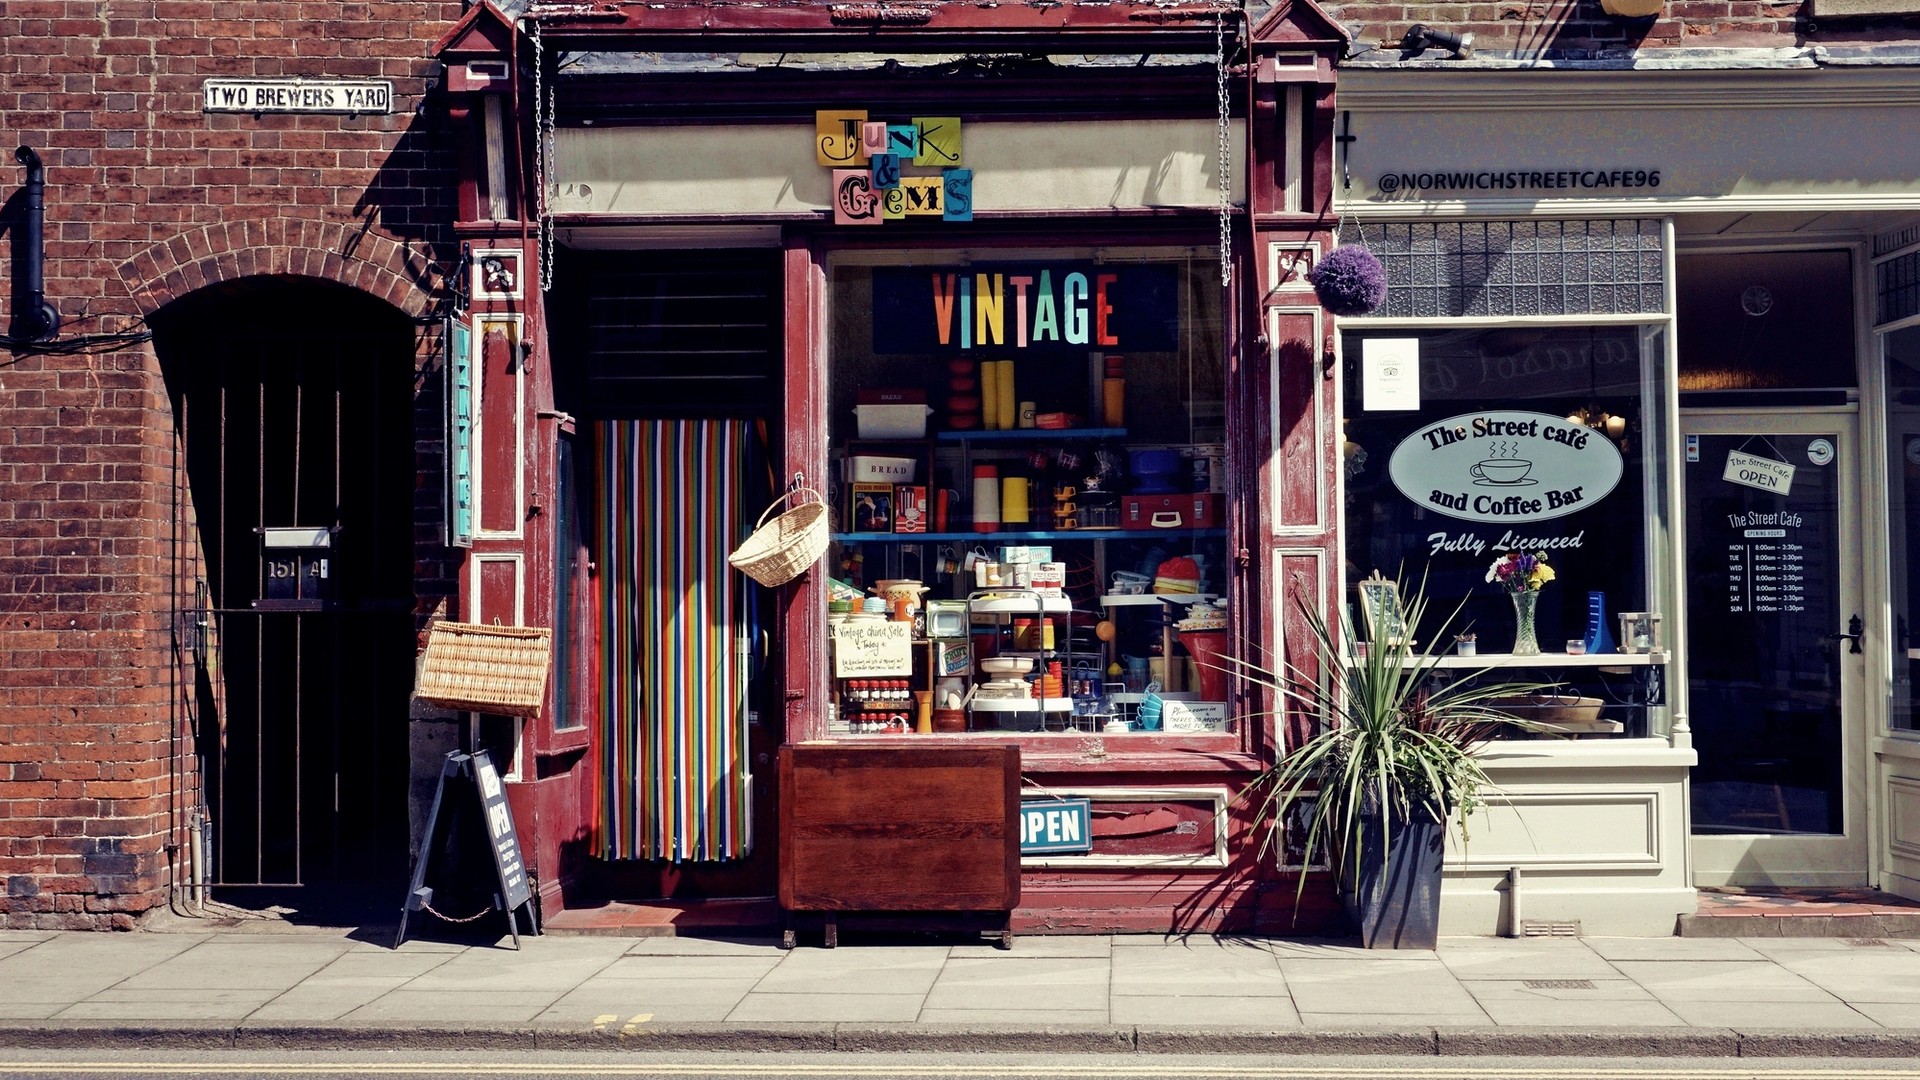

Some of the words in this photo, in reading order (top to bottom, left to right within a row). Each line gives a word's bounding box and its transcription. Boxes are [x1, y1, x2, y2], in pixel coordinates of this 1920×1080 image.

[210, 87, 248, 105] TWO
[256, 88, 334, 107] BREWERS
[345, 88, 386, 107] YARD
[876, 154, 898, 186] &
[1378, 169, 1661, 194] @NORWICHSTREETCAFE96
[932, 269, 1118, 349] VINTAGE
[1422, 425, 1467, 450] The
[1472, 417, 1538, 438] Street
[1543, 424, 1589, 450] café
[871, 465, 907, 475] BREAD
[1731, 458, 1746, 466] The
[1748, 458, 1772, 470] Street
[1773, 465, 1790, 480] Cafe
[1739, 469, 1778, 488] OPEN
[1429, 489, 1469, 511] and
[1473, 495, 1542, 515] Coffee
[1544, 486, 1584, 510] Bar
[1727, 514, 1747, 528] The
[1748, 511, 1778, 525] Street
[1780, 511, 1802, 528] Cafe
[1427, 531, 1486, 556] Fully
[1491, 530, 1584, 551] Licenced
[1782, 544, 1803, 552] 3:30pm
[269, 561, 296, 578] 151
[310, 561, 320, 577] A
[1782, 564, 1804, 572] 3:30pm
[839, 627, 864, 646] Vintage
[867, 626, 886, 638] china
[887, 625, 904, 640] Sale
[861, 640, 880, 657] Today
